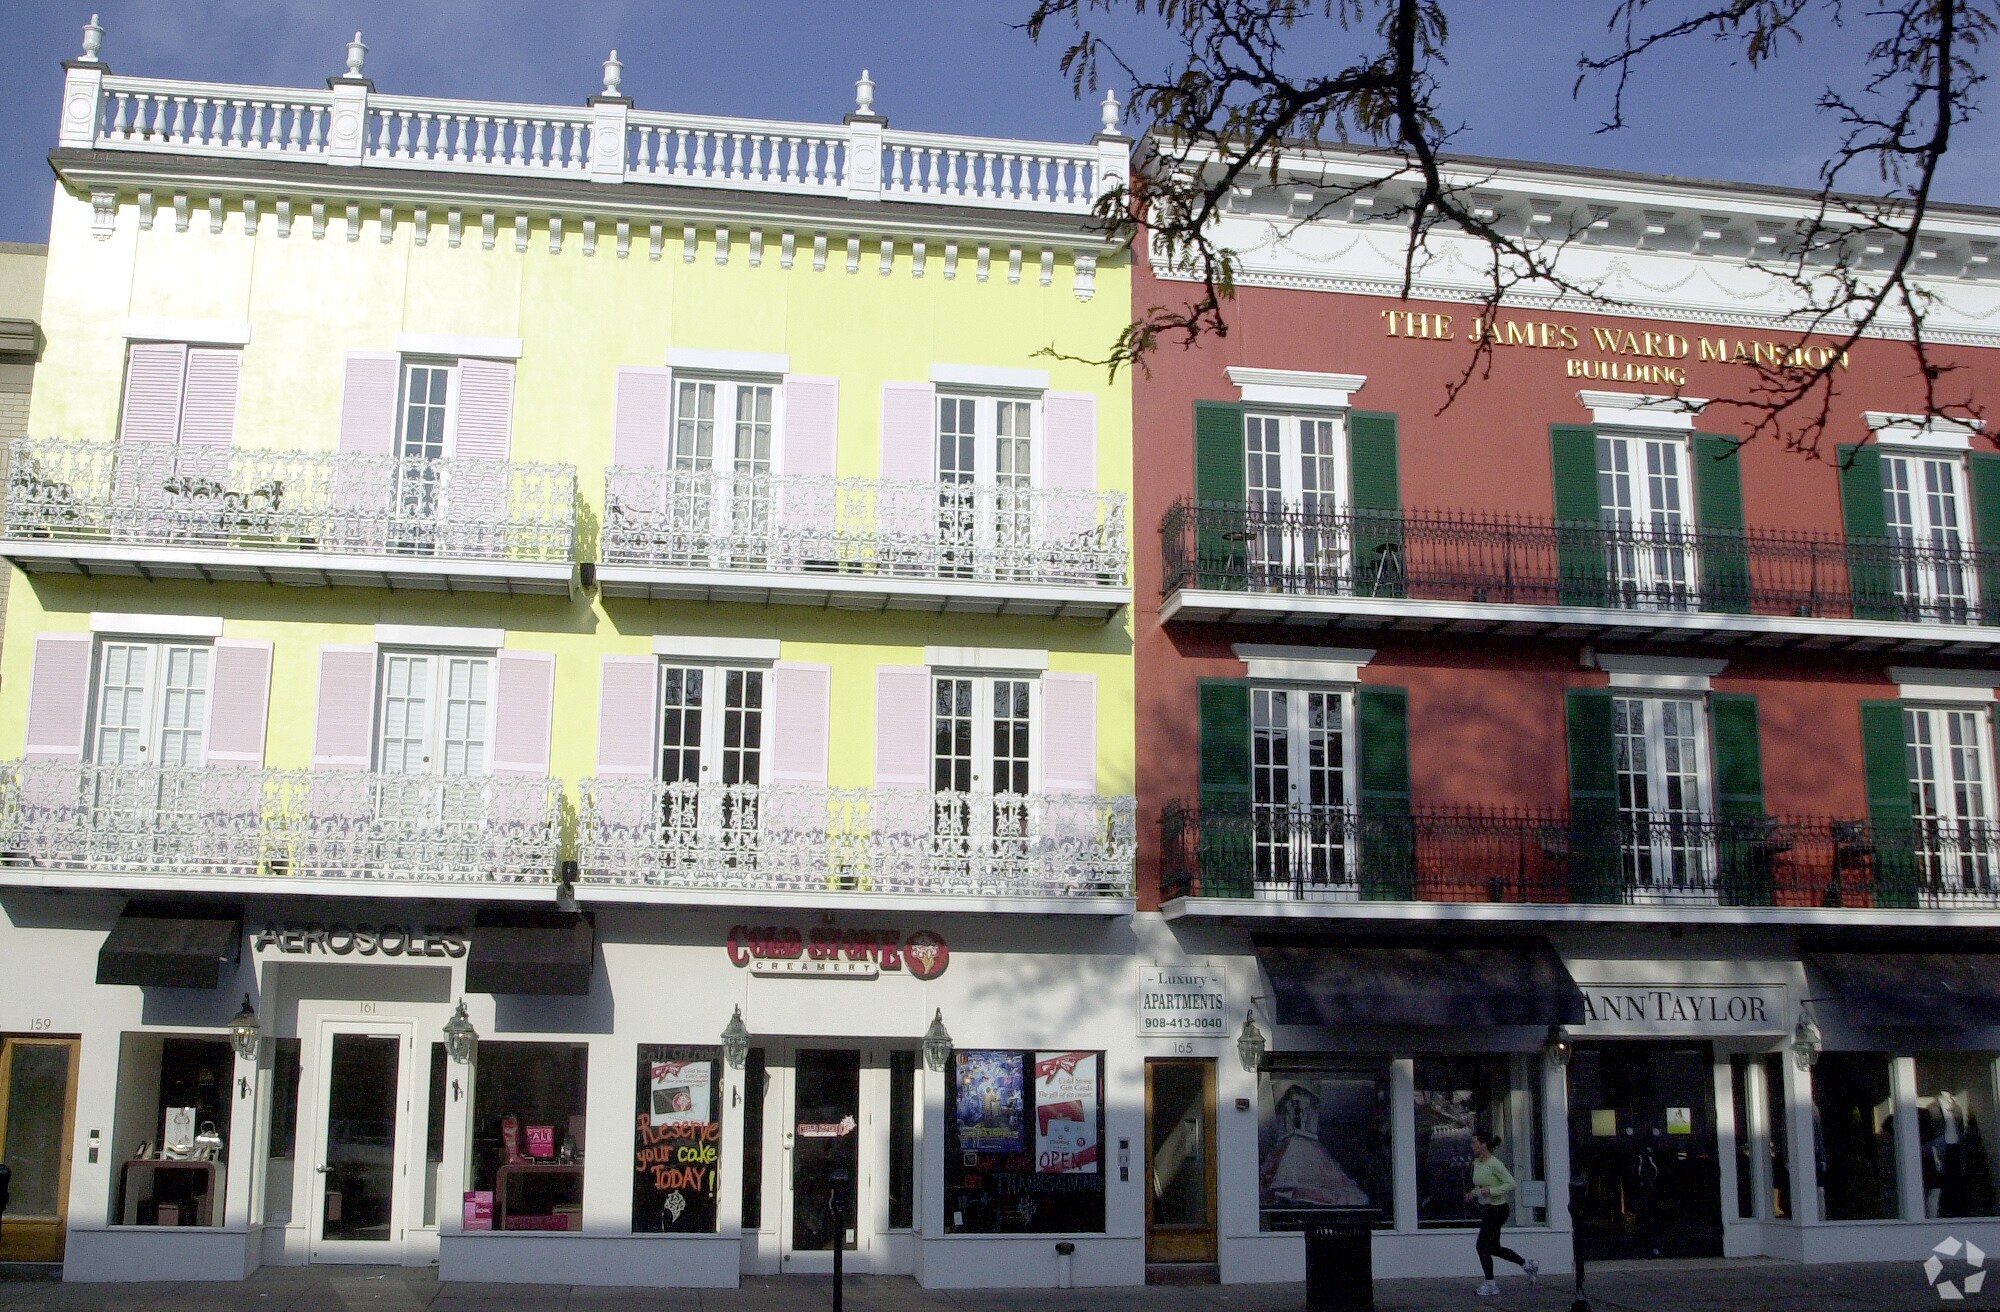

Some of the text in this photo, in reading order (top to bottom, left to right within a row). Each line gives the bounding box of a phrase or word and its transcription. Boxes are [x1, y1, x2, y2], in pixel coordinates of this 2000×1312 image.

[1382, 310, 1849, 371] THE JAMES WARD MANSION
[1566, 358, 1685, 386] BUILDING
[255, 925, 468, 958] AEROSOLES
[727, 925, 902, 971] COLD STONE
[755, 961, 871, 973] CREAMERY
[1158, 972, 1208, 989] Luxury
[360, 1001, 376, 1014] 161
[1143, 993, 1223, 1010] APARTMENTS
[30, 1018, 51, 1030] 159
[1144, 1017, 1222, 1029] 908-413-0040
[1173, 1042, 1193, 1054] 165
[637, 1113, 719, 1145] Reserve
[636, 1140, 717, 1172] your cake
[1039, 1151, 1083, 1170] OPEN
